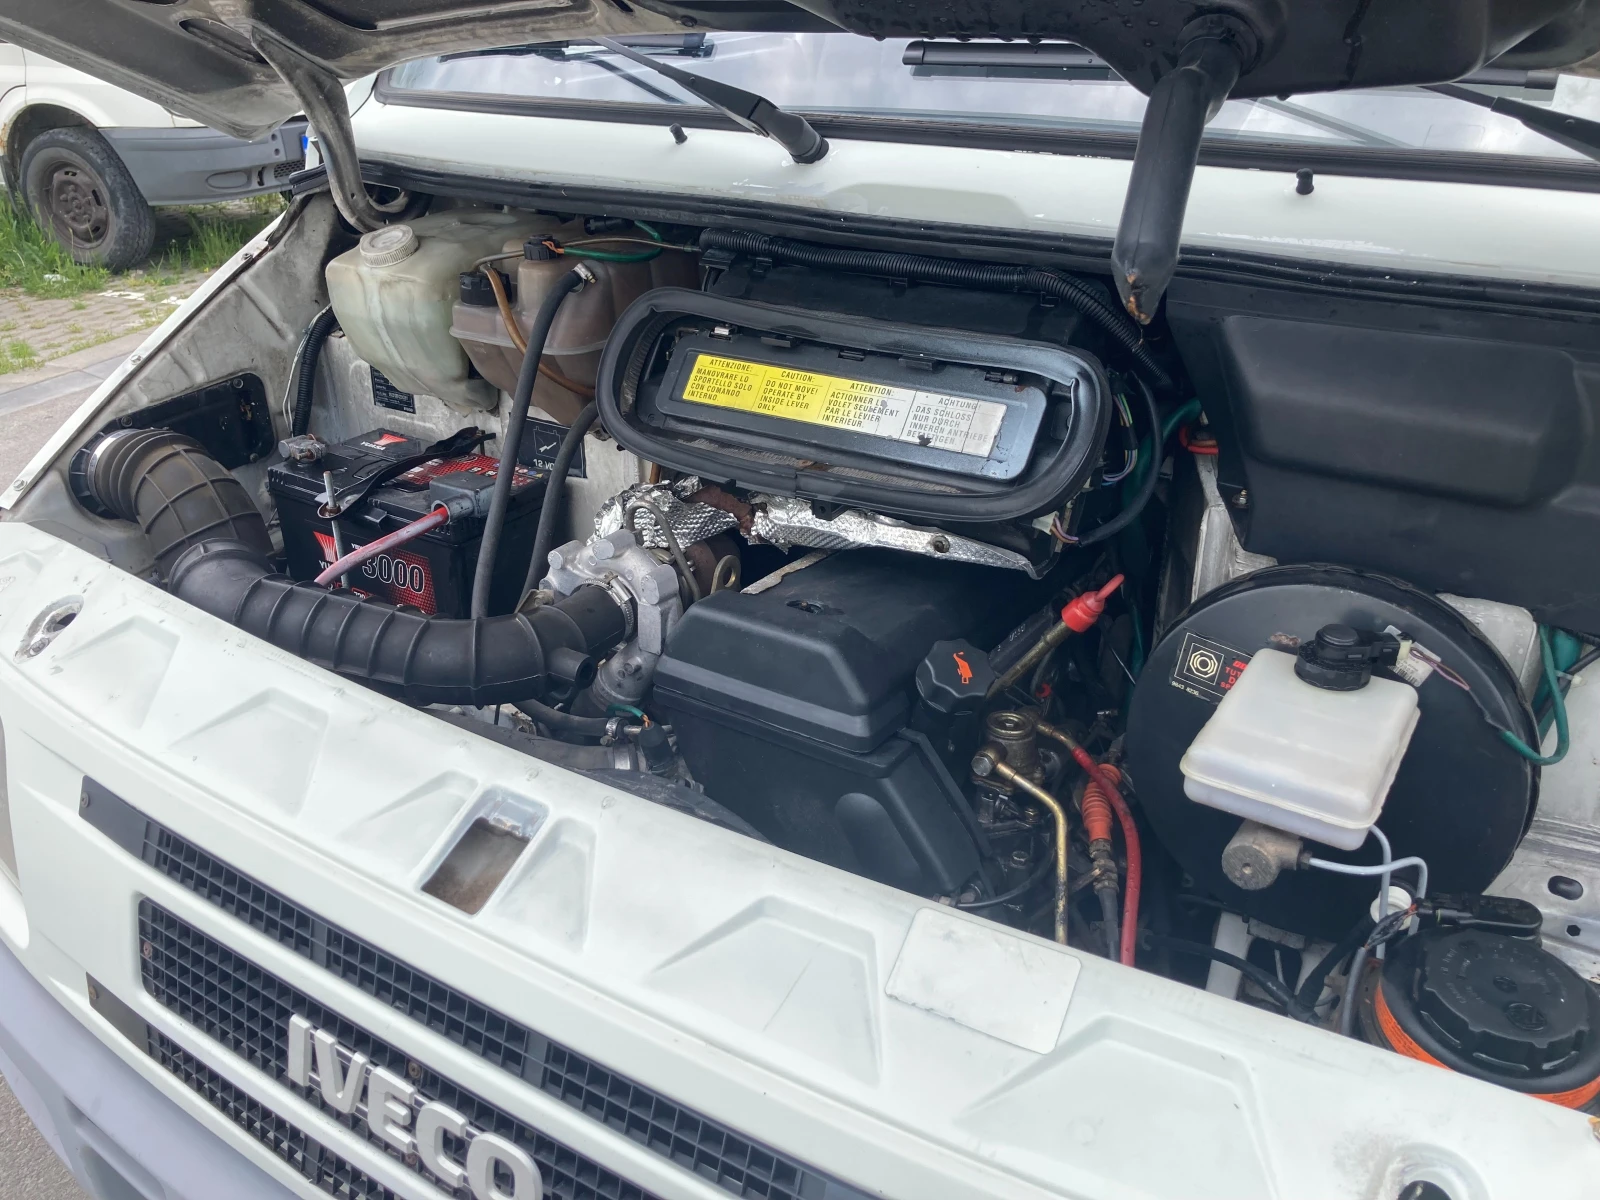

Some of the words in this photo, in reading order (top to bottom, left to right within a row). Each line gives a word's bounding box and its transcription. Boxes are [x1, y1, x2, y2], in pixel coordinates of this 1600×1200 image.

[709, 358, 753, 372] ATTENZIONE:
[696, 367, 738, 381] MANOVRARE
[739, 375, 749, 383] LO
[780, 370, 816, 383] CAUTION:
[690, 382, 704, 391] CON
[706, 385, 741, 398] COMANDO
[693, 375, 732, 388] SPORTELLO
[734, 383, 753, 392] SOLO
[765, 380, 776, 388] DO
[778, 381, 793, 391] NOT
[794, 385, 819, 395] MOVE!
[849, 382, 895, 397] ATTENTION:
[687, 390, 719, 402] INTERNO.
[763, 387, 795, 399] OPERATE
[796, 393, 807, 401] BY
[830, 391, 874, 405] ACTIONNER
[875, 398, 886, 408] L
[757, 402, 777, 412] ONLY.
[760, 394, 784, 406] INSIDE
[786, 400, 810, 410] LEVER
[828, 399, 851, 409] VOLET
[822, 413, 864, 429] INTERIEUR.
[824, 406, 840, 416] PAR
[841, 408, 851, 417] LE
[853, 411, 882, 423] LEVIER
[912, 413, 929, 423] NUR
[931, 416, 960, 428] DURCH
[915, 406, 931, 415] DAS
[933, 408, 972, 422] SCHLOSS
[946, 427, 989, 442] ANTRIEBE
[533, 459, 543, 467] 12
[362, 554, 425, 594] 3000
[288, 1014, 543, 1200] IVECO
